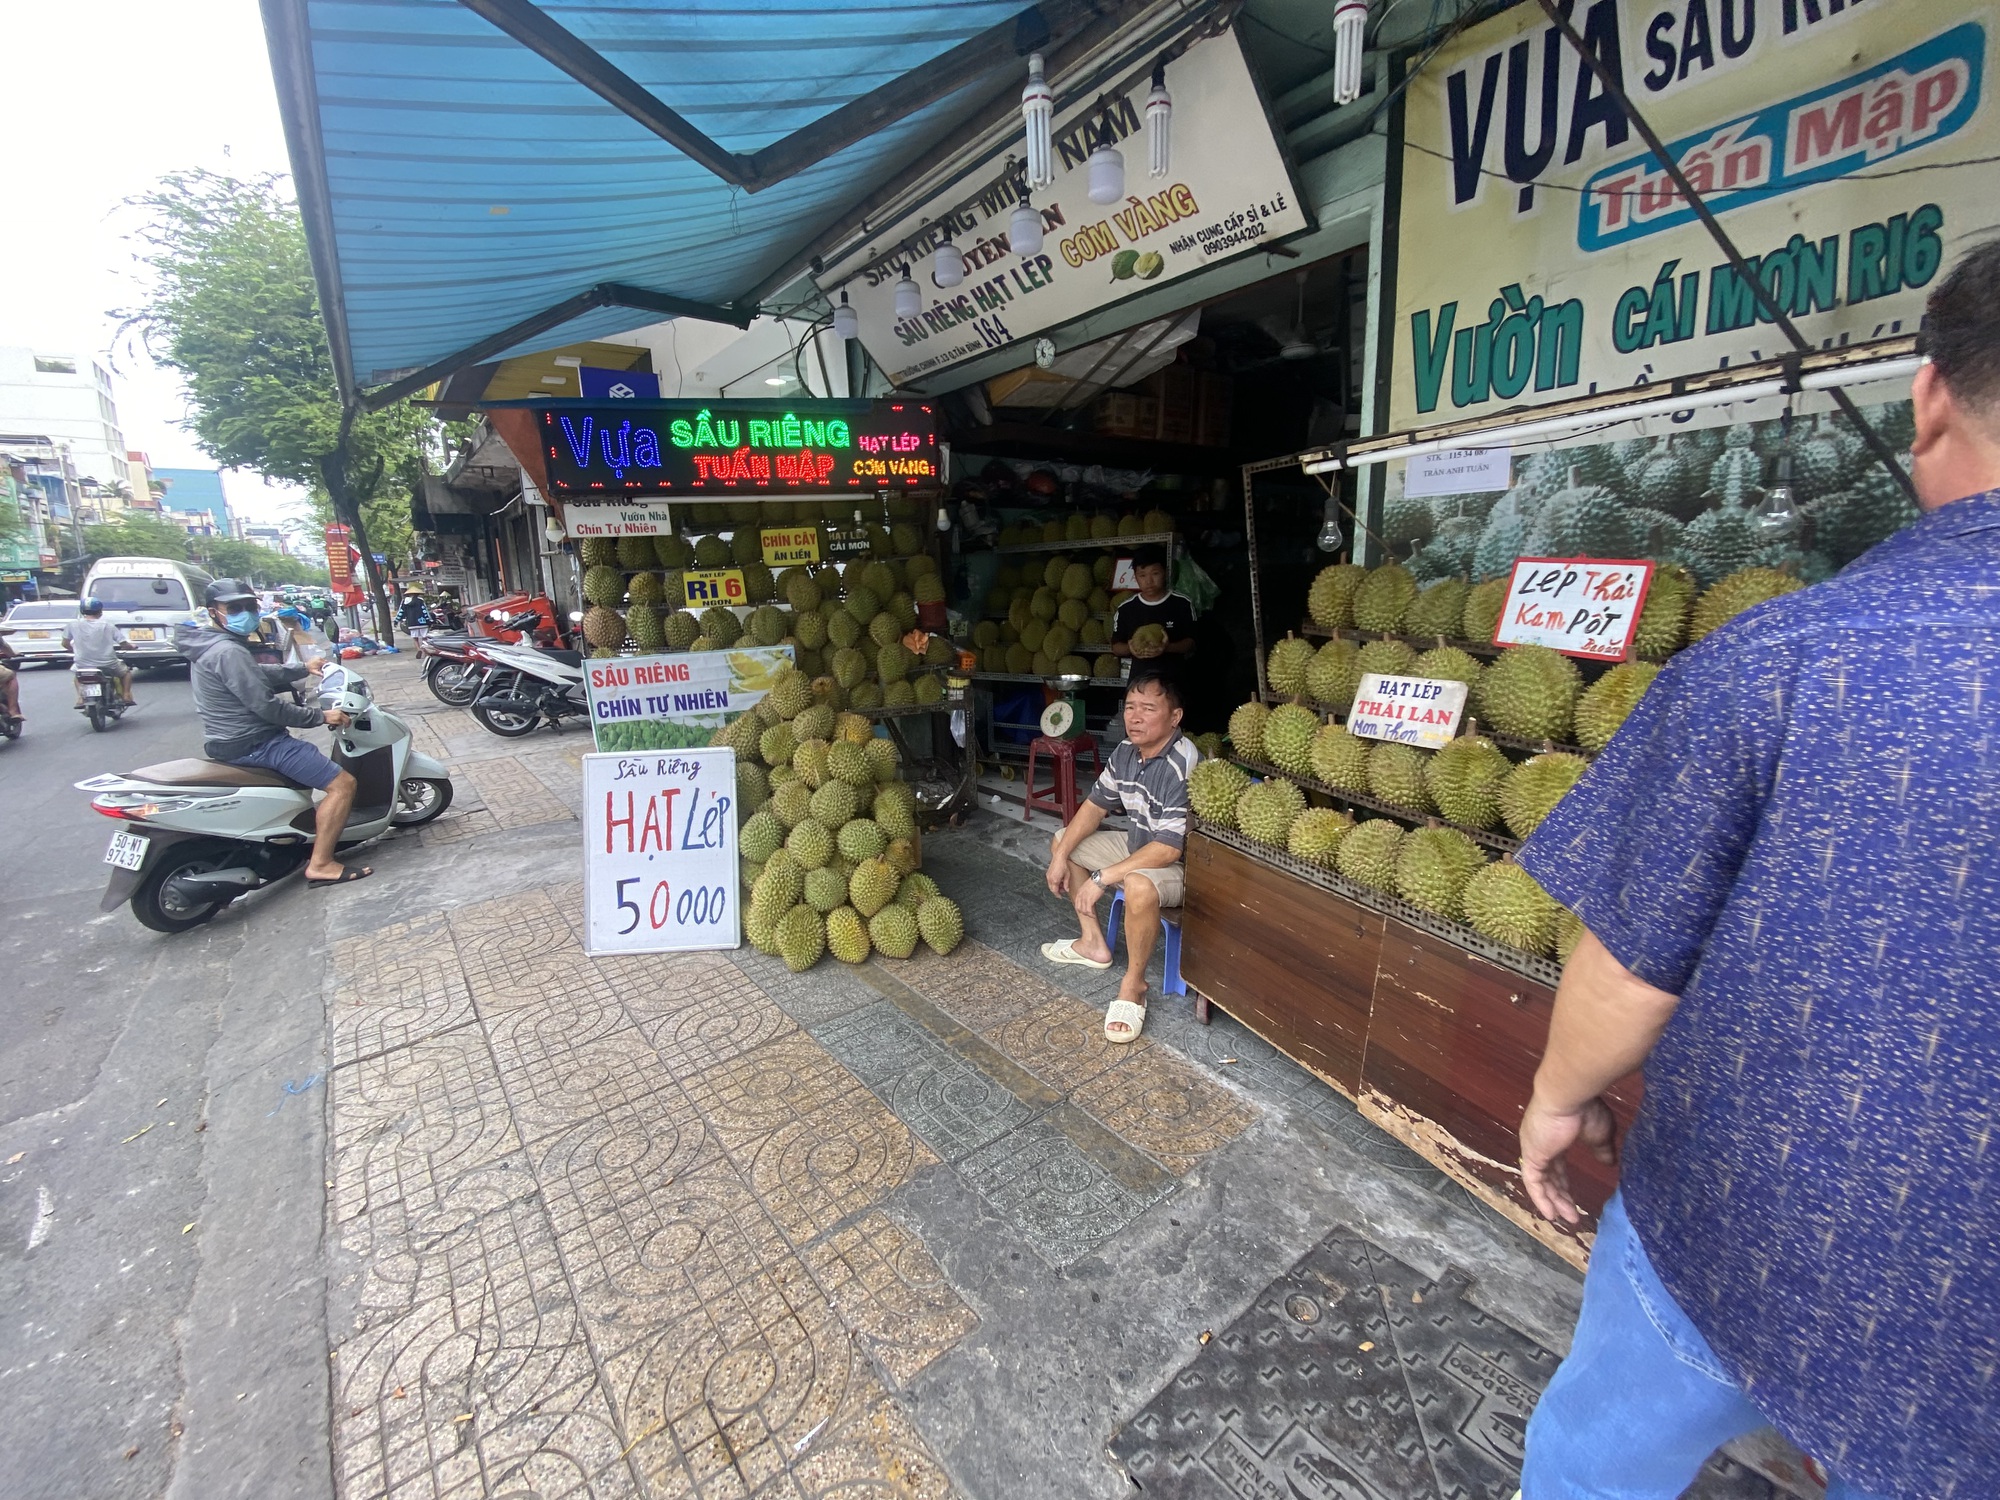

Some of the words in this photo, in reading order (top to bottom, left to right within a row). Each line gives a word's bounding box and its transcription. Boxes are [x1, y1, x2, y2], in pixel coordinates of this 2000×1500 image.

[1055, 96, 1142, 173] NAM
[1597, 134, 1762, 227] Tuấn
[1794, 66, 1958, 166] Mập
[1060, 224, 1120, 268] CƠM
[1113, 183, 1200, 242] VÀNG
[1169, 237, 1197, 255] NHẬN
[1197, 222, 1225, 244] CUNG
[1223, 212, 1245, 233] CẤP
[1261, 204, 1271, 217] &
[1203, 222, 1267, 256] 0903944202
[921, 294, 979, 335] RIÊNG
[970, 274, 1014, 314] HẠT
[1010, 253, 1054, 295] LÉP
[1411, 282, 1584, 415] Vườn
[1612, 258, 1697, 355] CÁI
[1706, 234, 1839, 336] MƠN
[1848, 202, 1945, 306] RI6
[972, 313, 1014, 349] 164
[560, 416, 662, 479] Vựa
[670, 408, 739, 448] SẦU
[748, 411, 851, 449] RIÊNG
[858, 435, 889, 454] HẠT
[891, 431, 921, 451] LÉP
[693, 446, 770, 480] TUẤN
[776, 449, 835, 483] MẬP
[853, 458, 886, 476] CƠM
[1426, 453, 1442, 462] STK
[1445, 466, 1464, 475] ANH
[620, 511, 645, 522] Vườn
[649, 510, 667, 521] Nhà
[576, 524, 602, 535] Chín
[605, 523, 621, 536] Tự
[625, 523, 657, 533] Nhiên
[762, 534, 791, 548] CHÍN
[794, 531, 816, 546] CÂY
[849, 541, 870, 550] MƠN
[687, 579, 719, 601] Ri
[725, 578, 742, 598] 6
[1583, 571, 1634, 602] Thái
[1515, 602, 1566, 631] Kam
[591, 662, 629, 688] SẦU
[635, 662, 690, 685] RIÊNG
[1377, 680, 1410, 698] HẠT
[1412, 681, 1442, 700] LÉP
[596, 695, 642, 719] CHÍN
[646, 693, 670, 720] TỰ
[674, 688, 729, 712] NHIÊN
[1357, 699, 1406, 720] THÁI
[1407, 706, 1454, 726] LAN
[1352, 719, 1378, 736] Mon
[1382, 720, 1418, 743] Thon
[657, 758, 702, 781] Riêng
[605, 788, 681, 861] HẠT
[114, 834, 142, 853] 50-N1
[106, 848, 141, 867] 974.37
